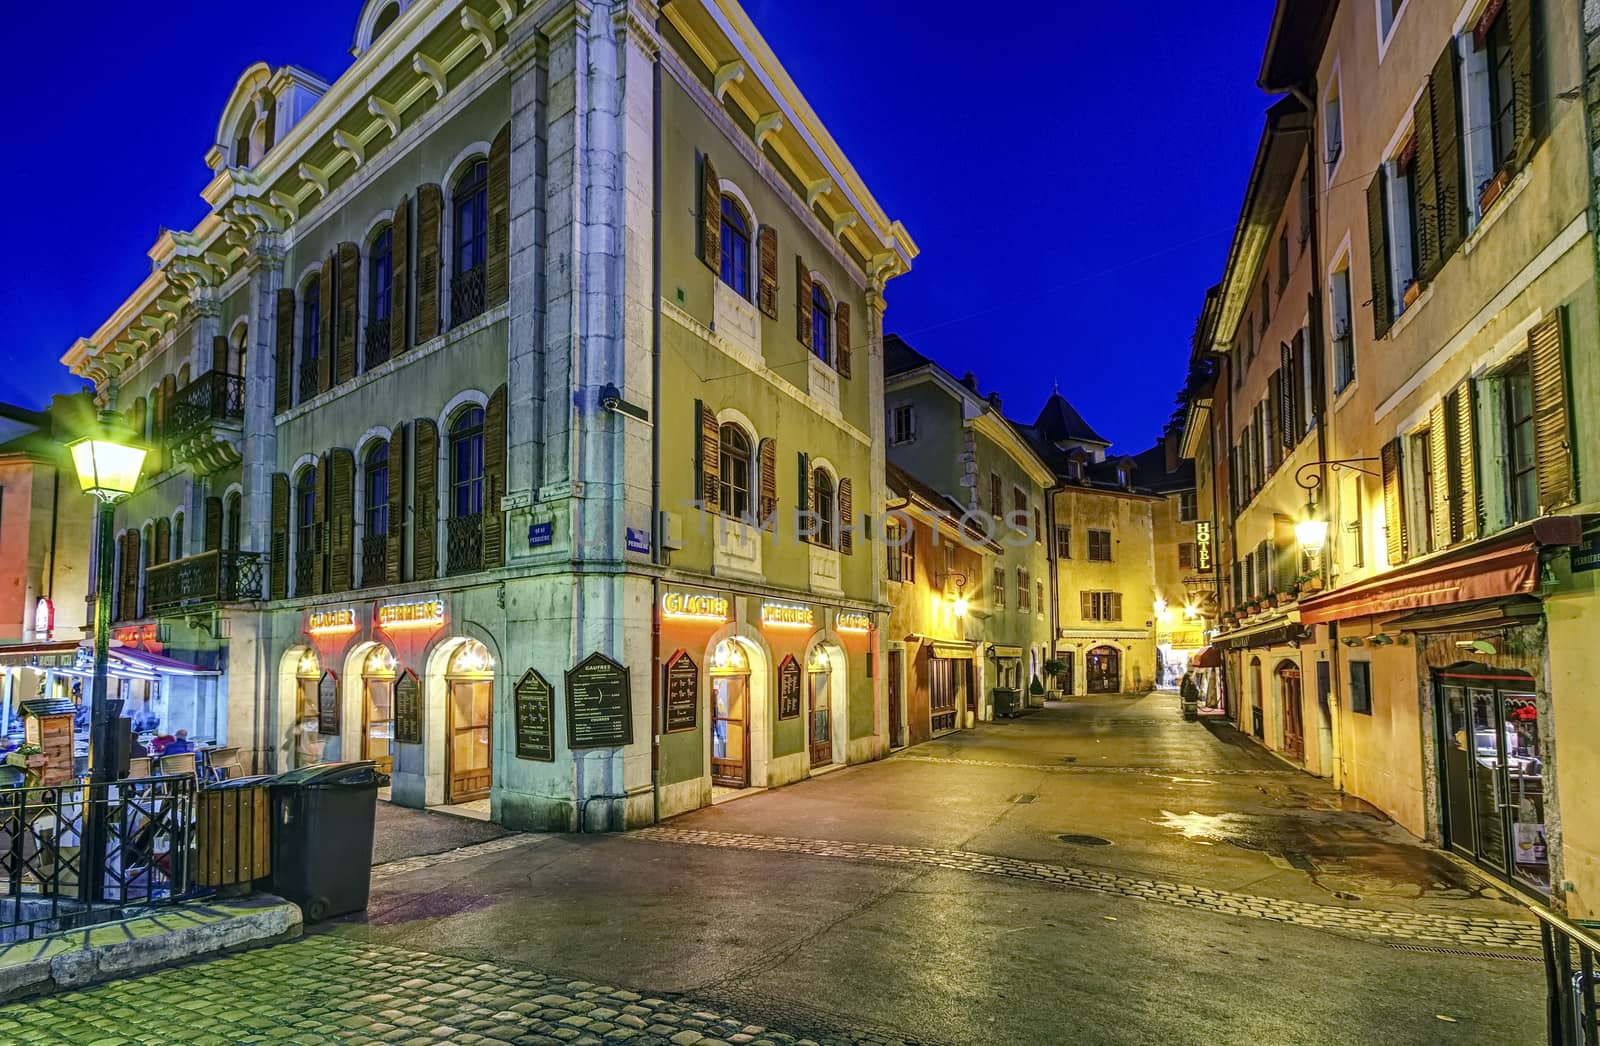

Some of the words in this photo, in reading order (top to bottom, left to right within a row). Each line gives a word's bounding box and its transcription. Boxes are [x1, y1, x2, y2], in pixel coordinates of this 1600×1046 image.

[1196, 522, 1210, 570] HOTEL
[662, 592, 728, 616] GLACIER
[309, 609, 355, 628] GLACIER
